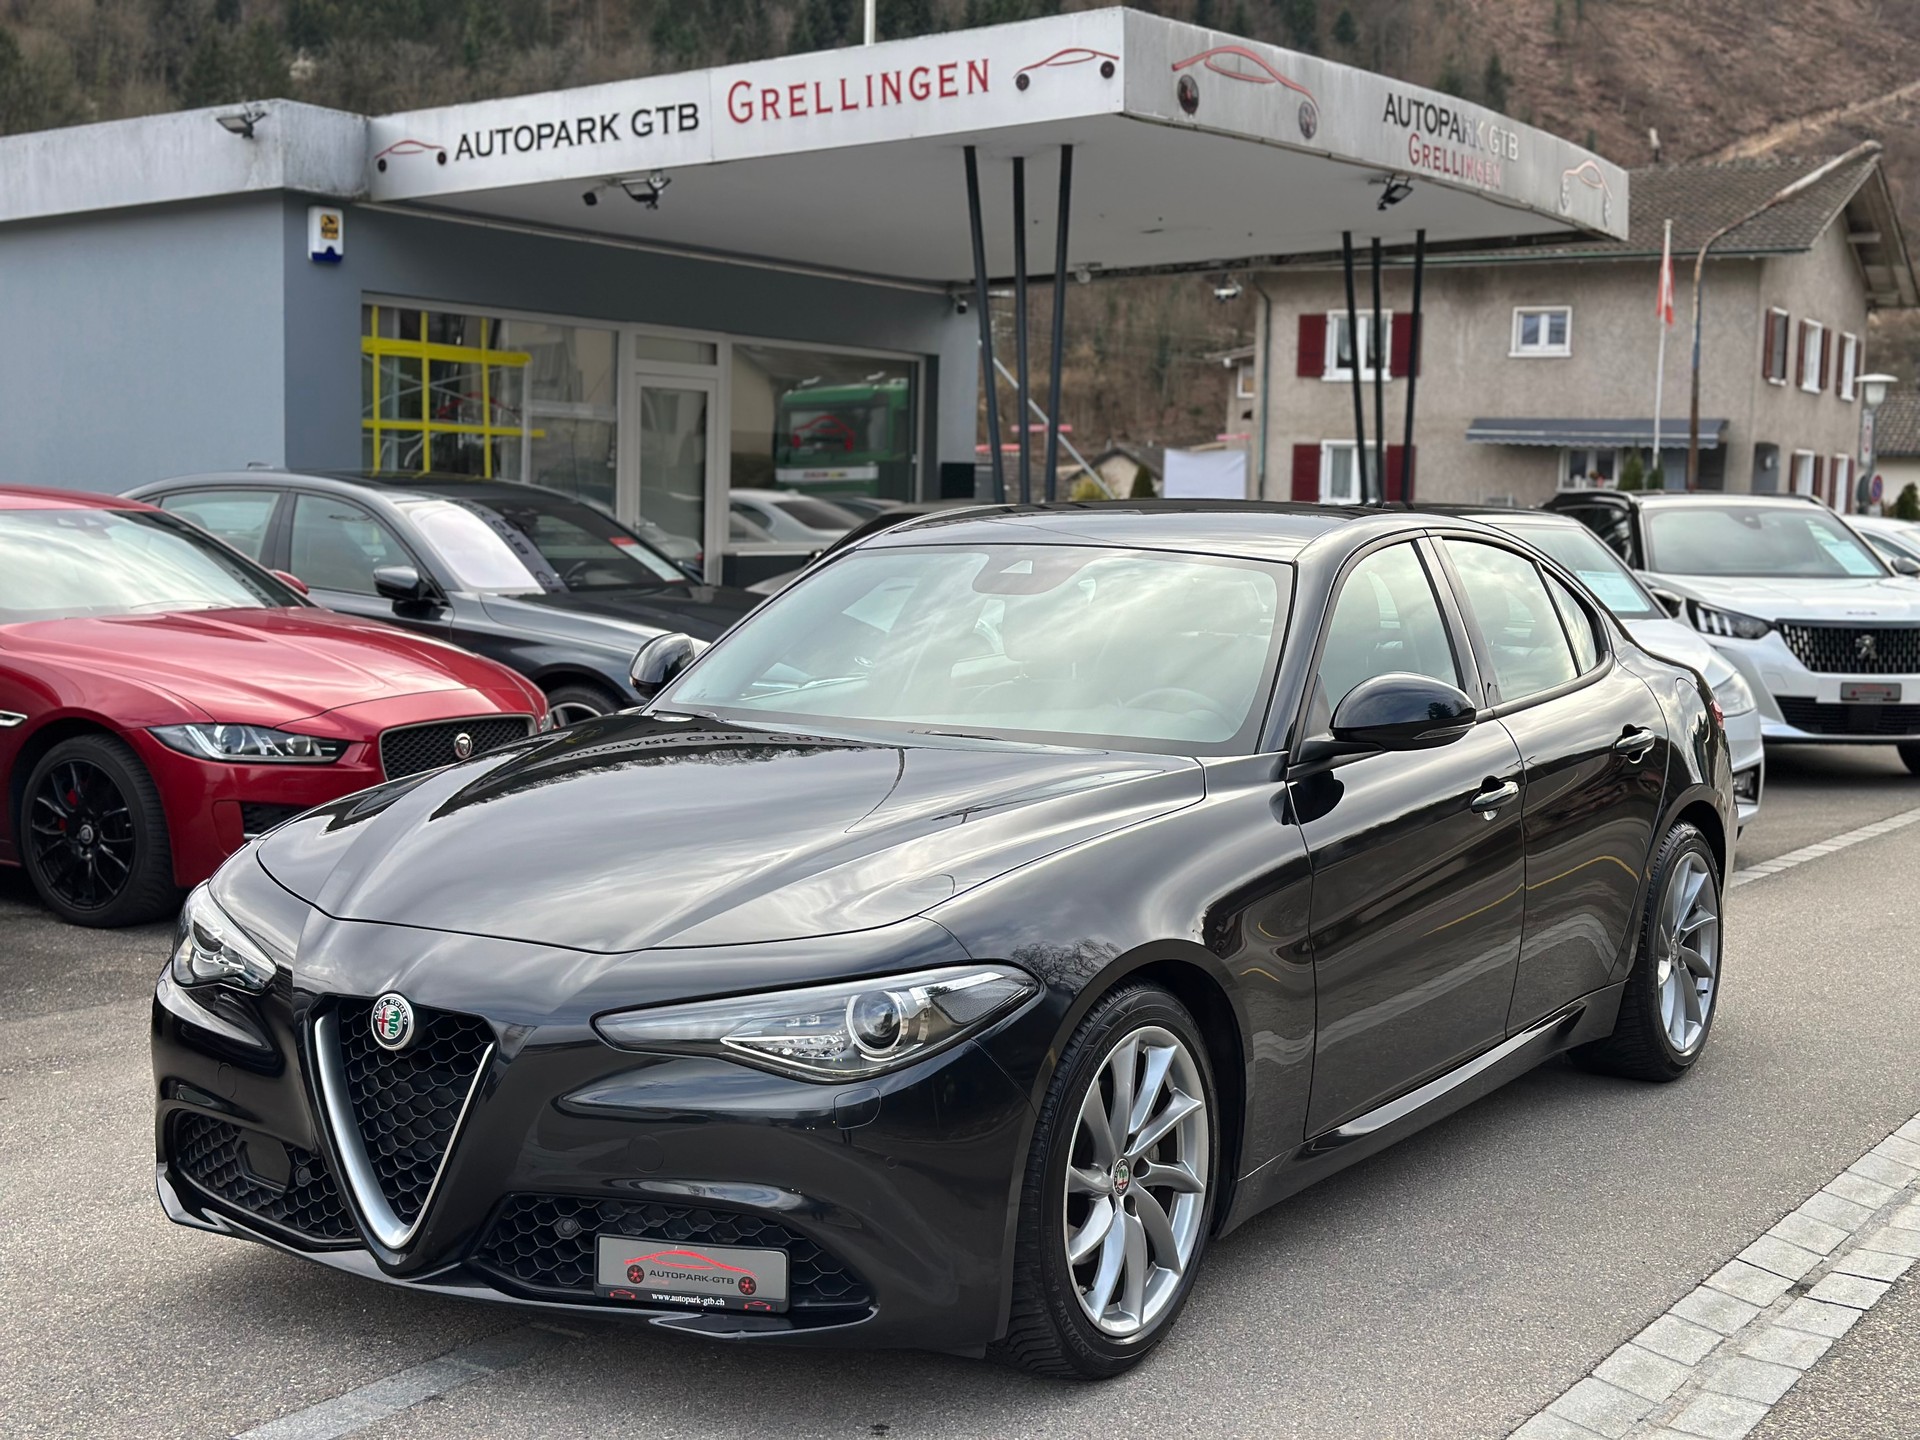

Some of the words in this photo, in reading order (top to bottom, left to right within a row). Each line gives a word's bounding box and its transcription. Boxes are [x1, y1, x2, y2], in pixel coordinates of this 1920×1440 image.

[454, 112, 621, 161] AUTOPARK
[631, 102, 700, 137] GTB
[727, 57, 991, 125] GRELLINGEN
[1382, 93, 1484, 151] AUTOPARK
[1488, 125, 1519, 161] GTB
[1408, 133, 1501, 189] GRELLINGEN
[649, 1269, 735, 1285] AUTOPARK-GTB
[651, 1293, 726, 1306] www.autopark-gtb.ch
